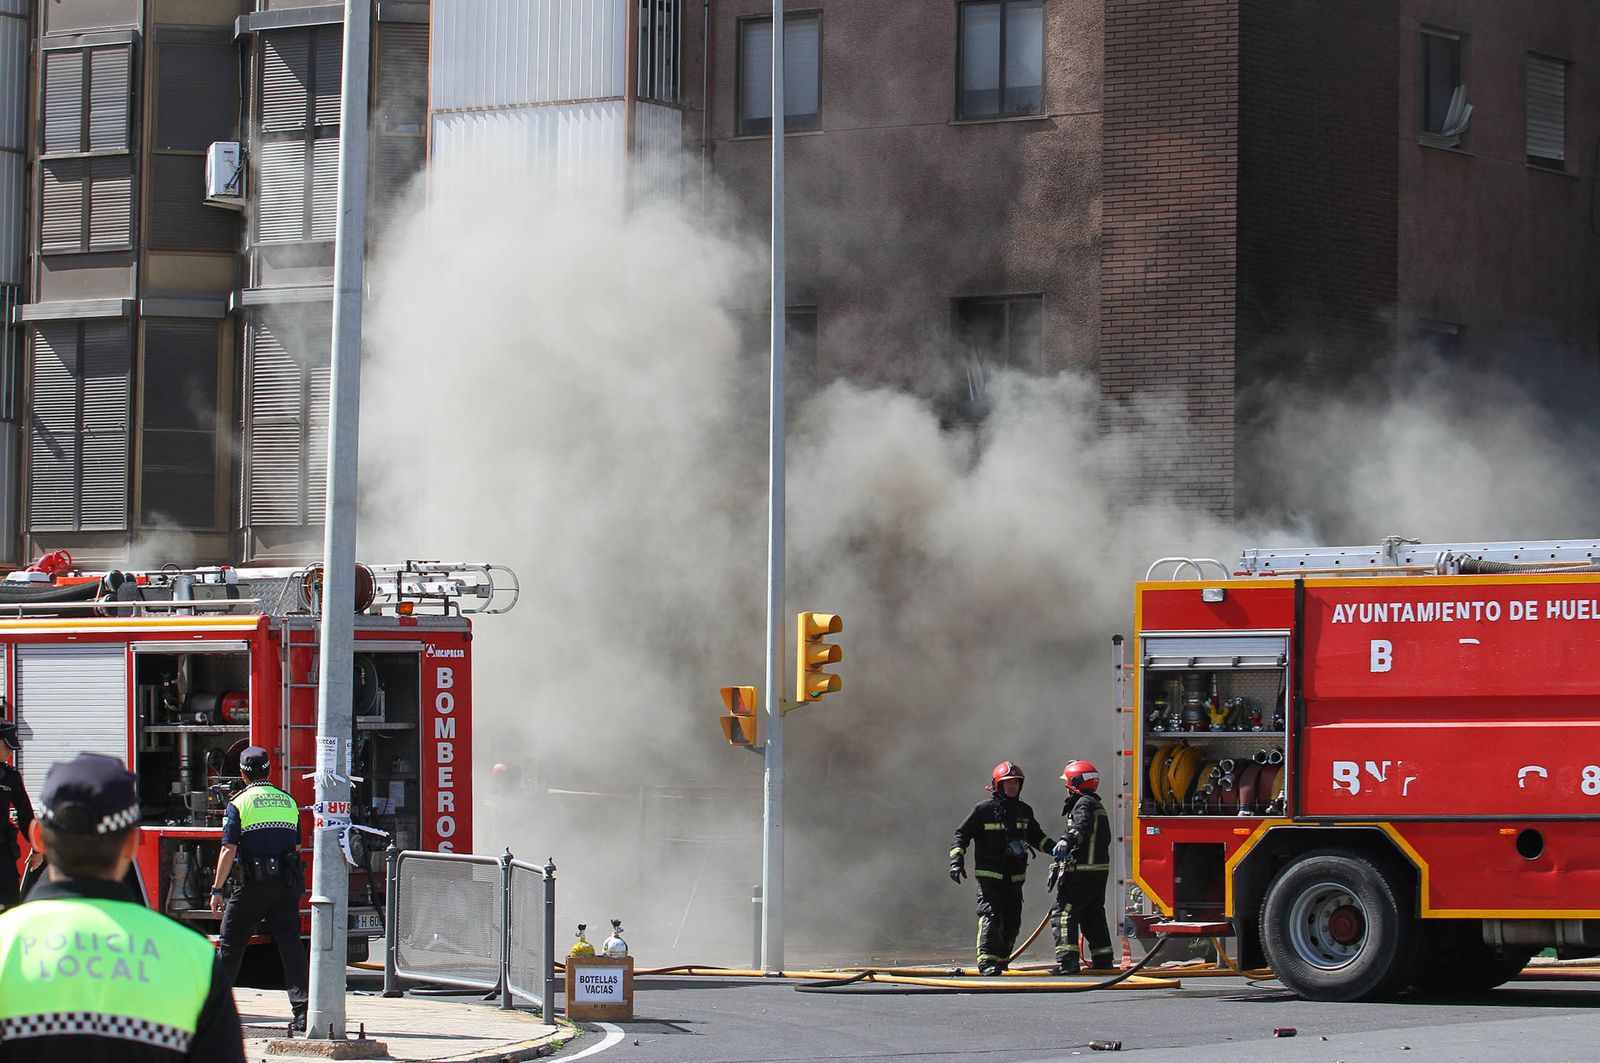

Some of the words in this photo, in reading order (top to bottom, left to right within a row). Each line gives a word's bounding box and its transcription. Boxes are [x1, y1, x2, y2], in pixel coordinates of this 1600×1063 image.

[1331, 601, 1501, 623] AYUNTAMIENTO
[1509, 601, 1538, 621] DE
[434, 666, 456, 855] BOMBEROS
[22, 931, 161, 961] POLICIA
[40, 955, 150, 984] LOCAL
[579, 975, 618, 984] BOTELLAS
